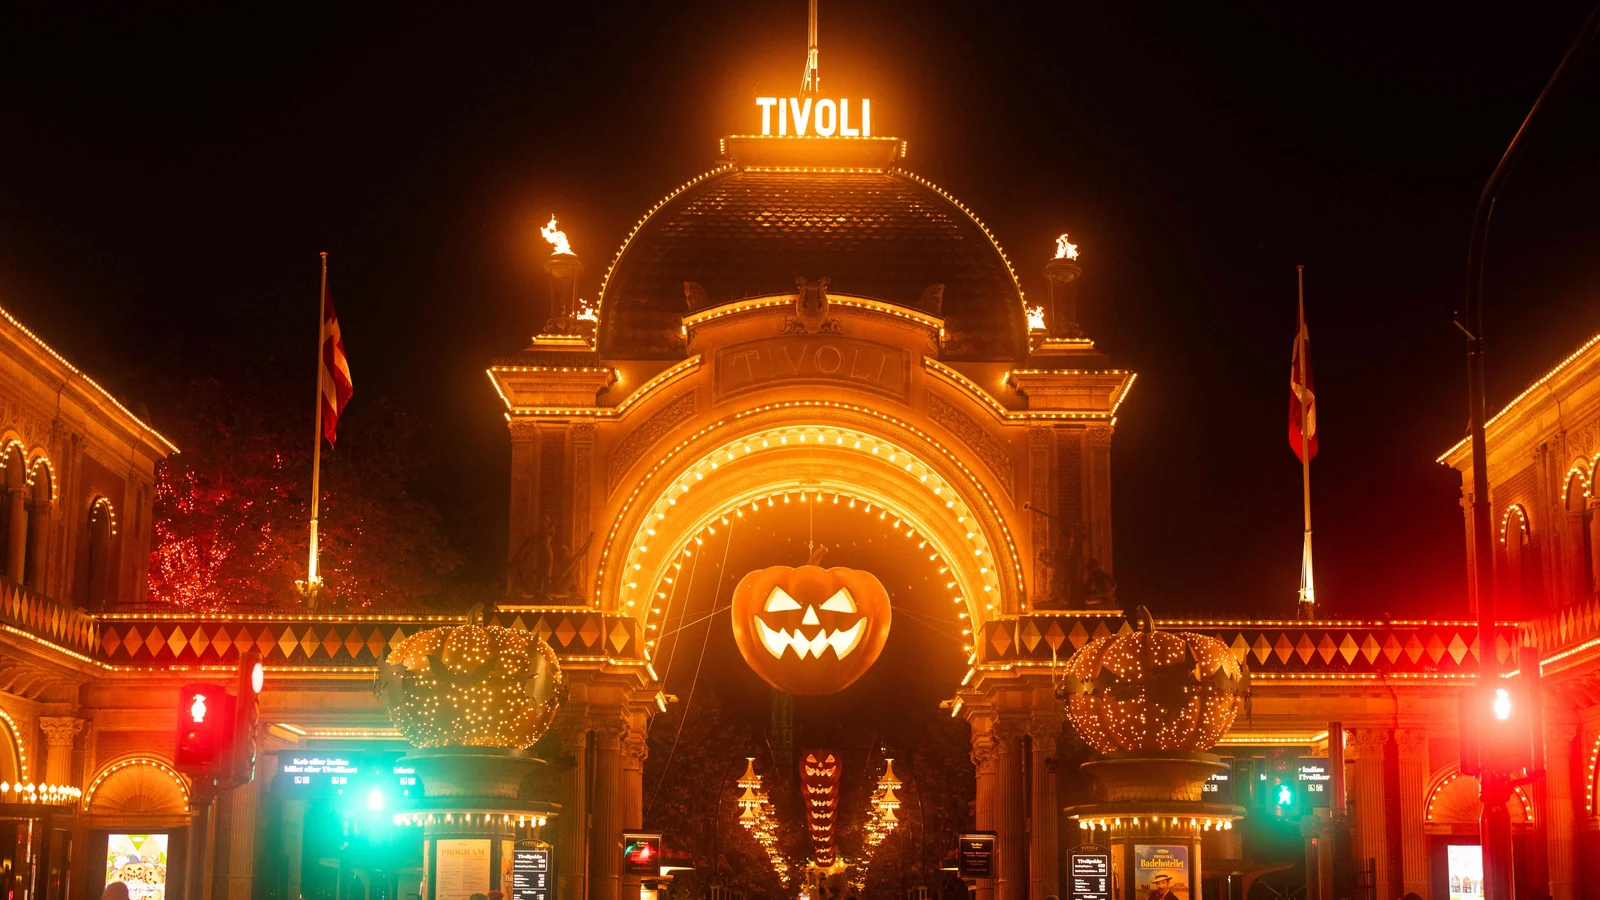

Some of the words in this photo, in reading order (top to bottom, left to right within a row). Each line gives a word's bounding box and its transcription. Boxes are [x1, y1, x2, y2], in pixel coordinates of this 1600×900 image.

[756, 97, 871, 137] TIVOLI
[731, 346, 888, 382] TIVOLI
[441, 848, 485, 856] PROGRAM
[1140, 858, 1184, 868] Badehotellet
